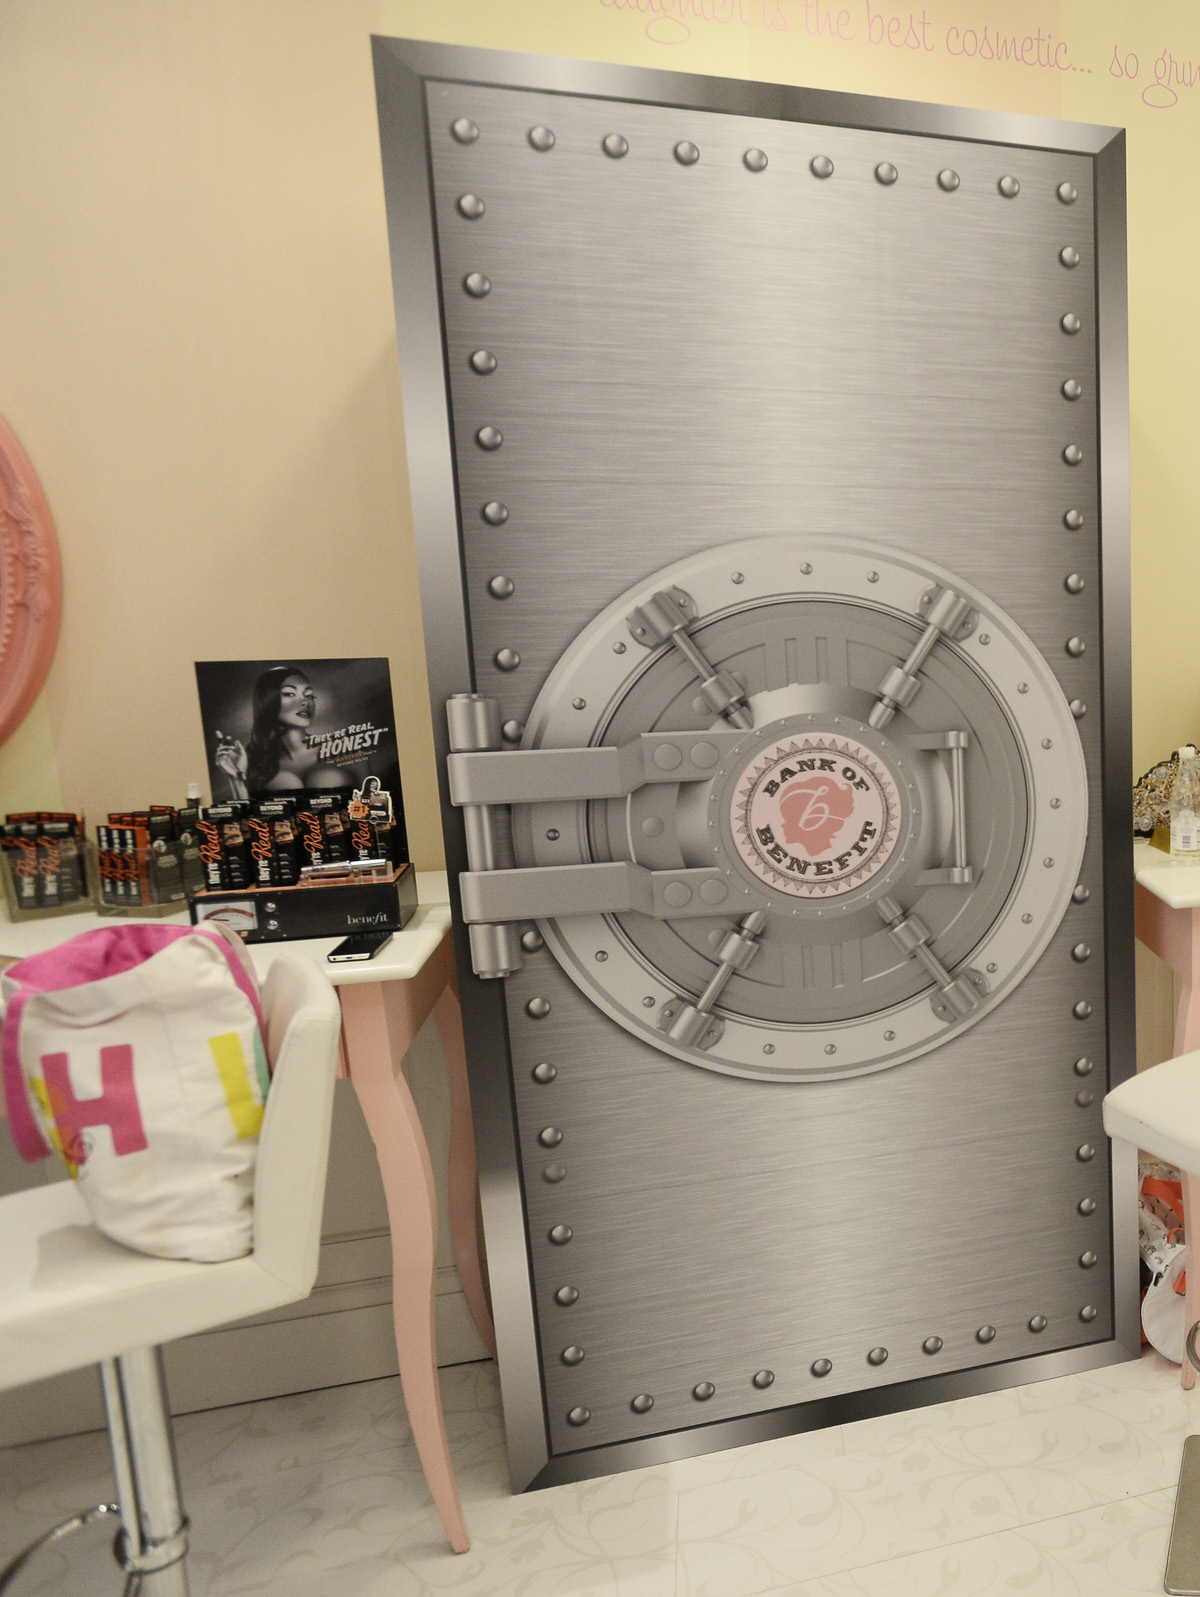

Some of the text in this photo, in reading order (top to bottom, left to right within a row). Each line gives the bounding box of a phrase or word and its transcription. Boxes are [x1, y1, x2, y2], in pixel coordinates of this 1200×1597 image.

[800, 0, 857, 40] the
[866, 0, 935, 51] best
[946, 25, 1092, 74] cosmetic...
[1109, 44, 1139, 79] so
[762, 757, 870, 798] BANK OF
[195, 821, 222, 864] Real!
[248, 818, 273, 861] Real!
[300, 812, 324, 853] Real!
[755, 820, 877, 877] BENEFIT
[347, 912, 388, 926] benefit
